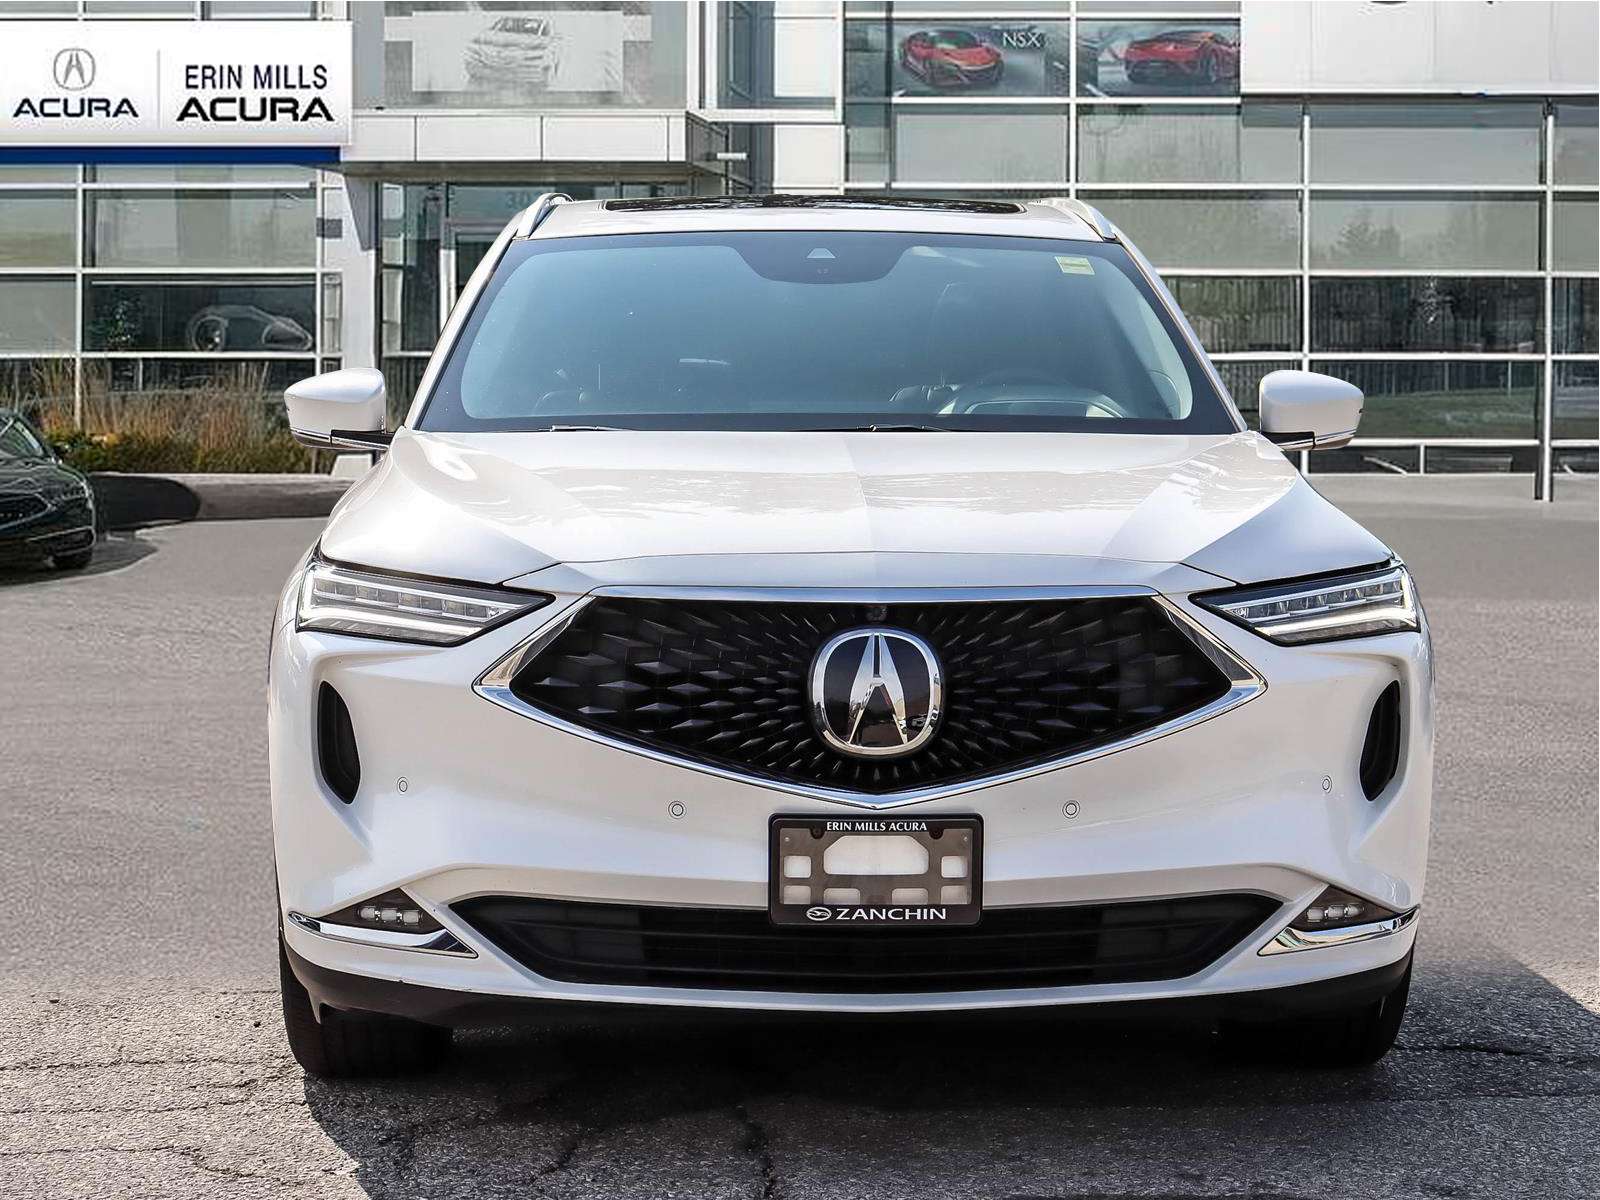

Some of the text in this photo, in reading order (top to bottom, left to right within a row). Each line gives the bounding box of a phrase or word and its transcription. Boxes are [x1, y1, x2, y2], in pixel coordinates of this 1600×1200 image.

[1003, 32, 1041, 48] NSX
[185, 64, 328, 90] ERIN MILLS
[13, 97, 139, 118] ACURA
[176, 96, 335, 122] ACURA
[826, 821, 928, 832] ERIN MILLS ACURA
[835, 908, 947, 920] ZANCHIN
